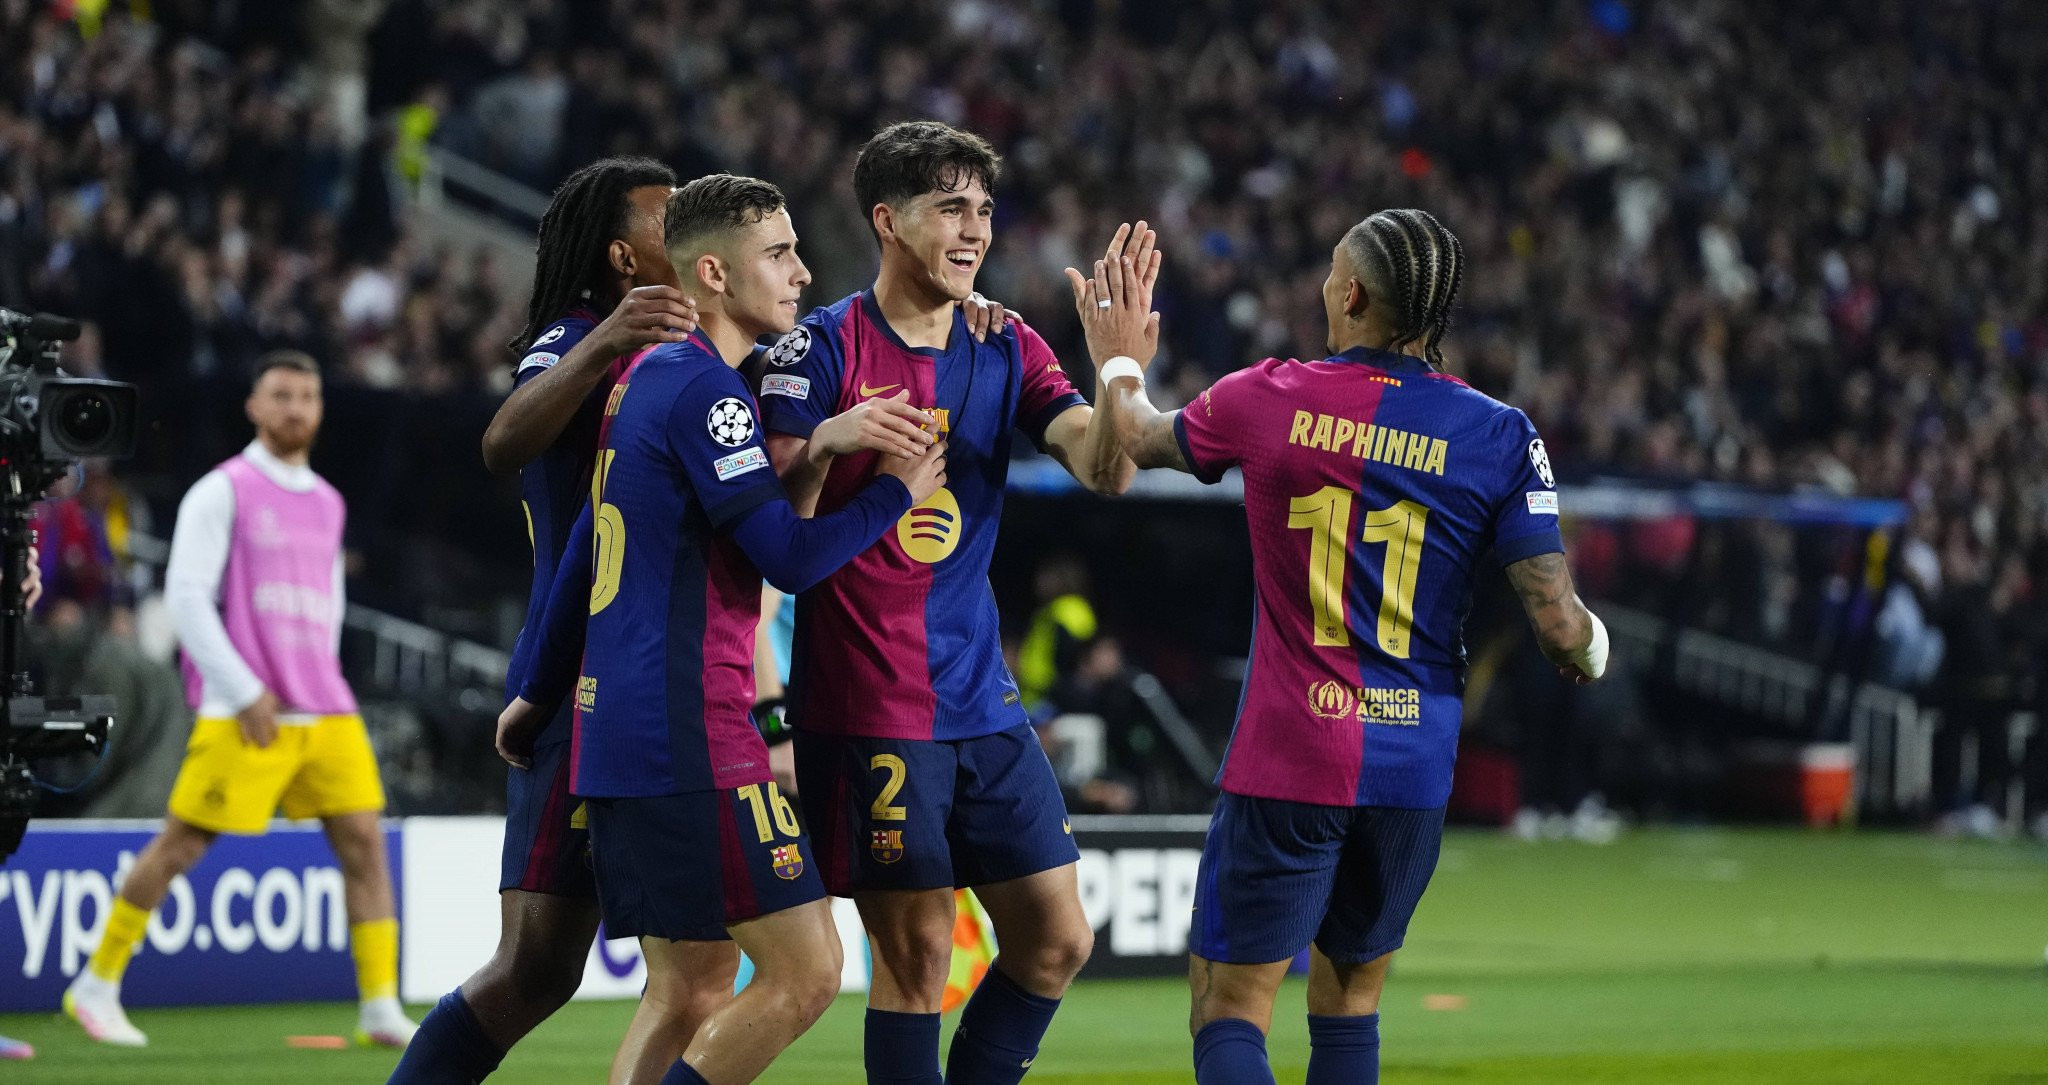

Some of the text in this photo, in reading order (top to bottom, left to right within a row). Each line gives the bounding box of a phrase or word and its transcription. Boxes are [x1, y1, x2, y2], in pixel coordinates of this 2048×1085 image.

[1288, 409, 1449, 476] RAPHINHA
[1287, 485, 1430, 659] 11
[1355, 701, 1420, 719] ACNUR
[1356, 687, 1420, 704] UNHCR
[736, 781, 801, 844] 16
[870, 753, 907, 821] 2
